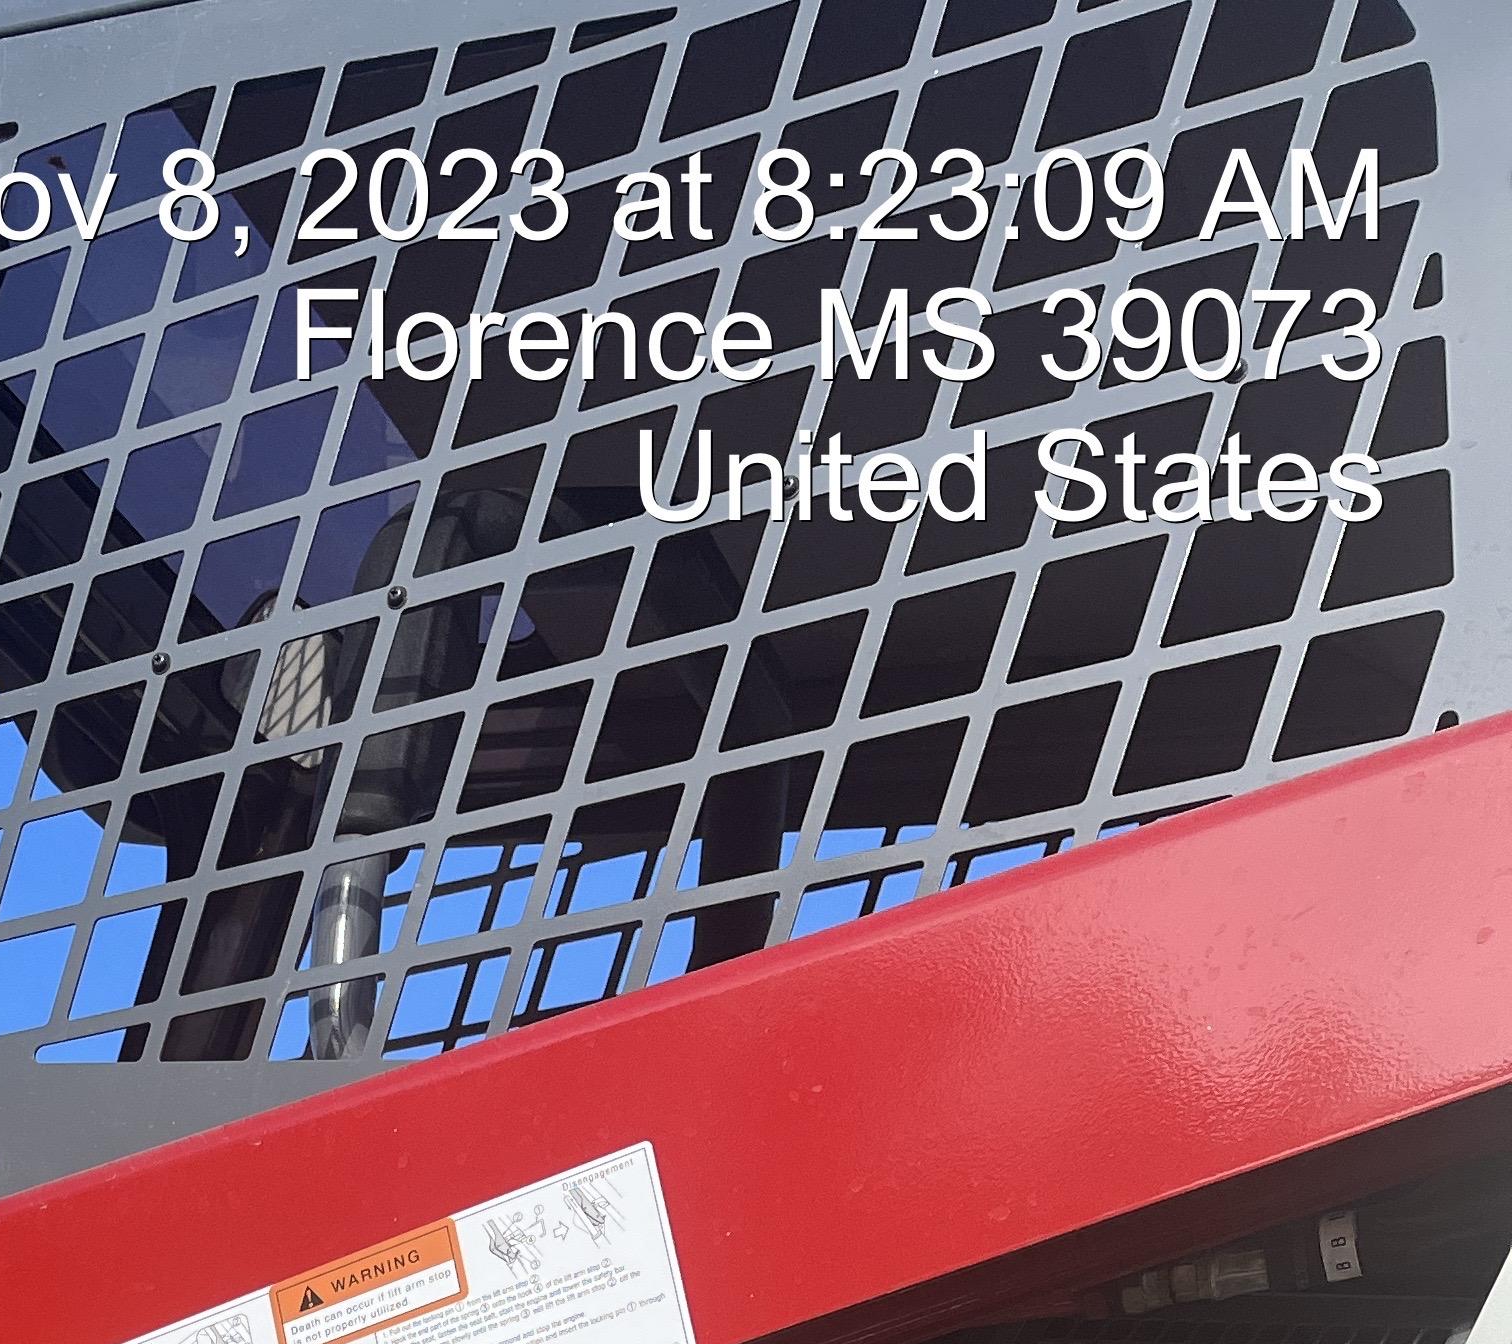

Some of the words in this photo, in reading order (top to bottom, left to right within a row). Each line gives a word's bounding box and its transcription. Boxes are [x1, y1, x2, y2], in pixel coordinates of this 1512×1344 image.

[561, 1156, 634, 1192] Disengagement
[330, 1248, 420, 1294] WARNING
[290, 1316, 321, 1335] Death
[323, 1308, 342, 1323] can
[344, 1295, 375, 1315] occur
[386, 1285, 402, 1299] lift
[403, 1276, 425, 1293] arm
[427, 1267, 451, 1284] stop
[304, 1329, 322, 1344] not
[323, 1312, 368, 1338] properly
